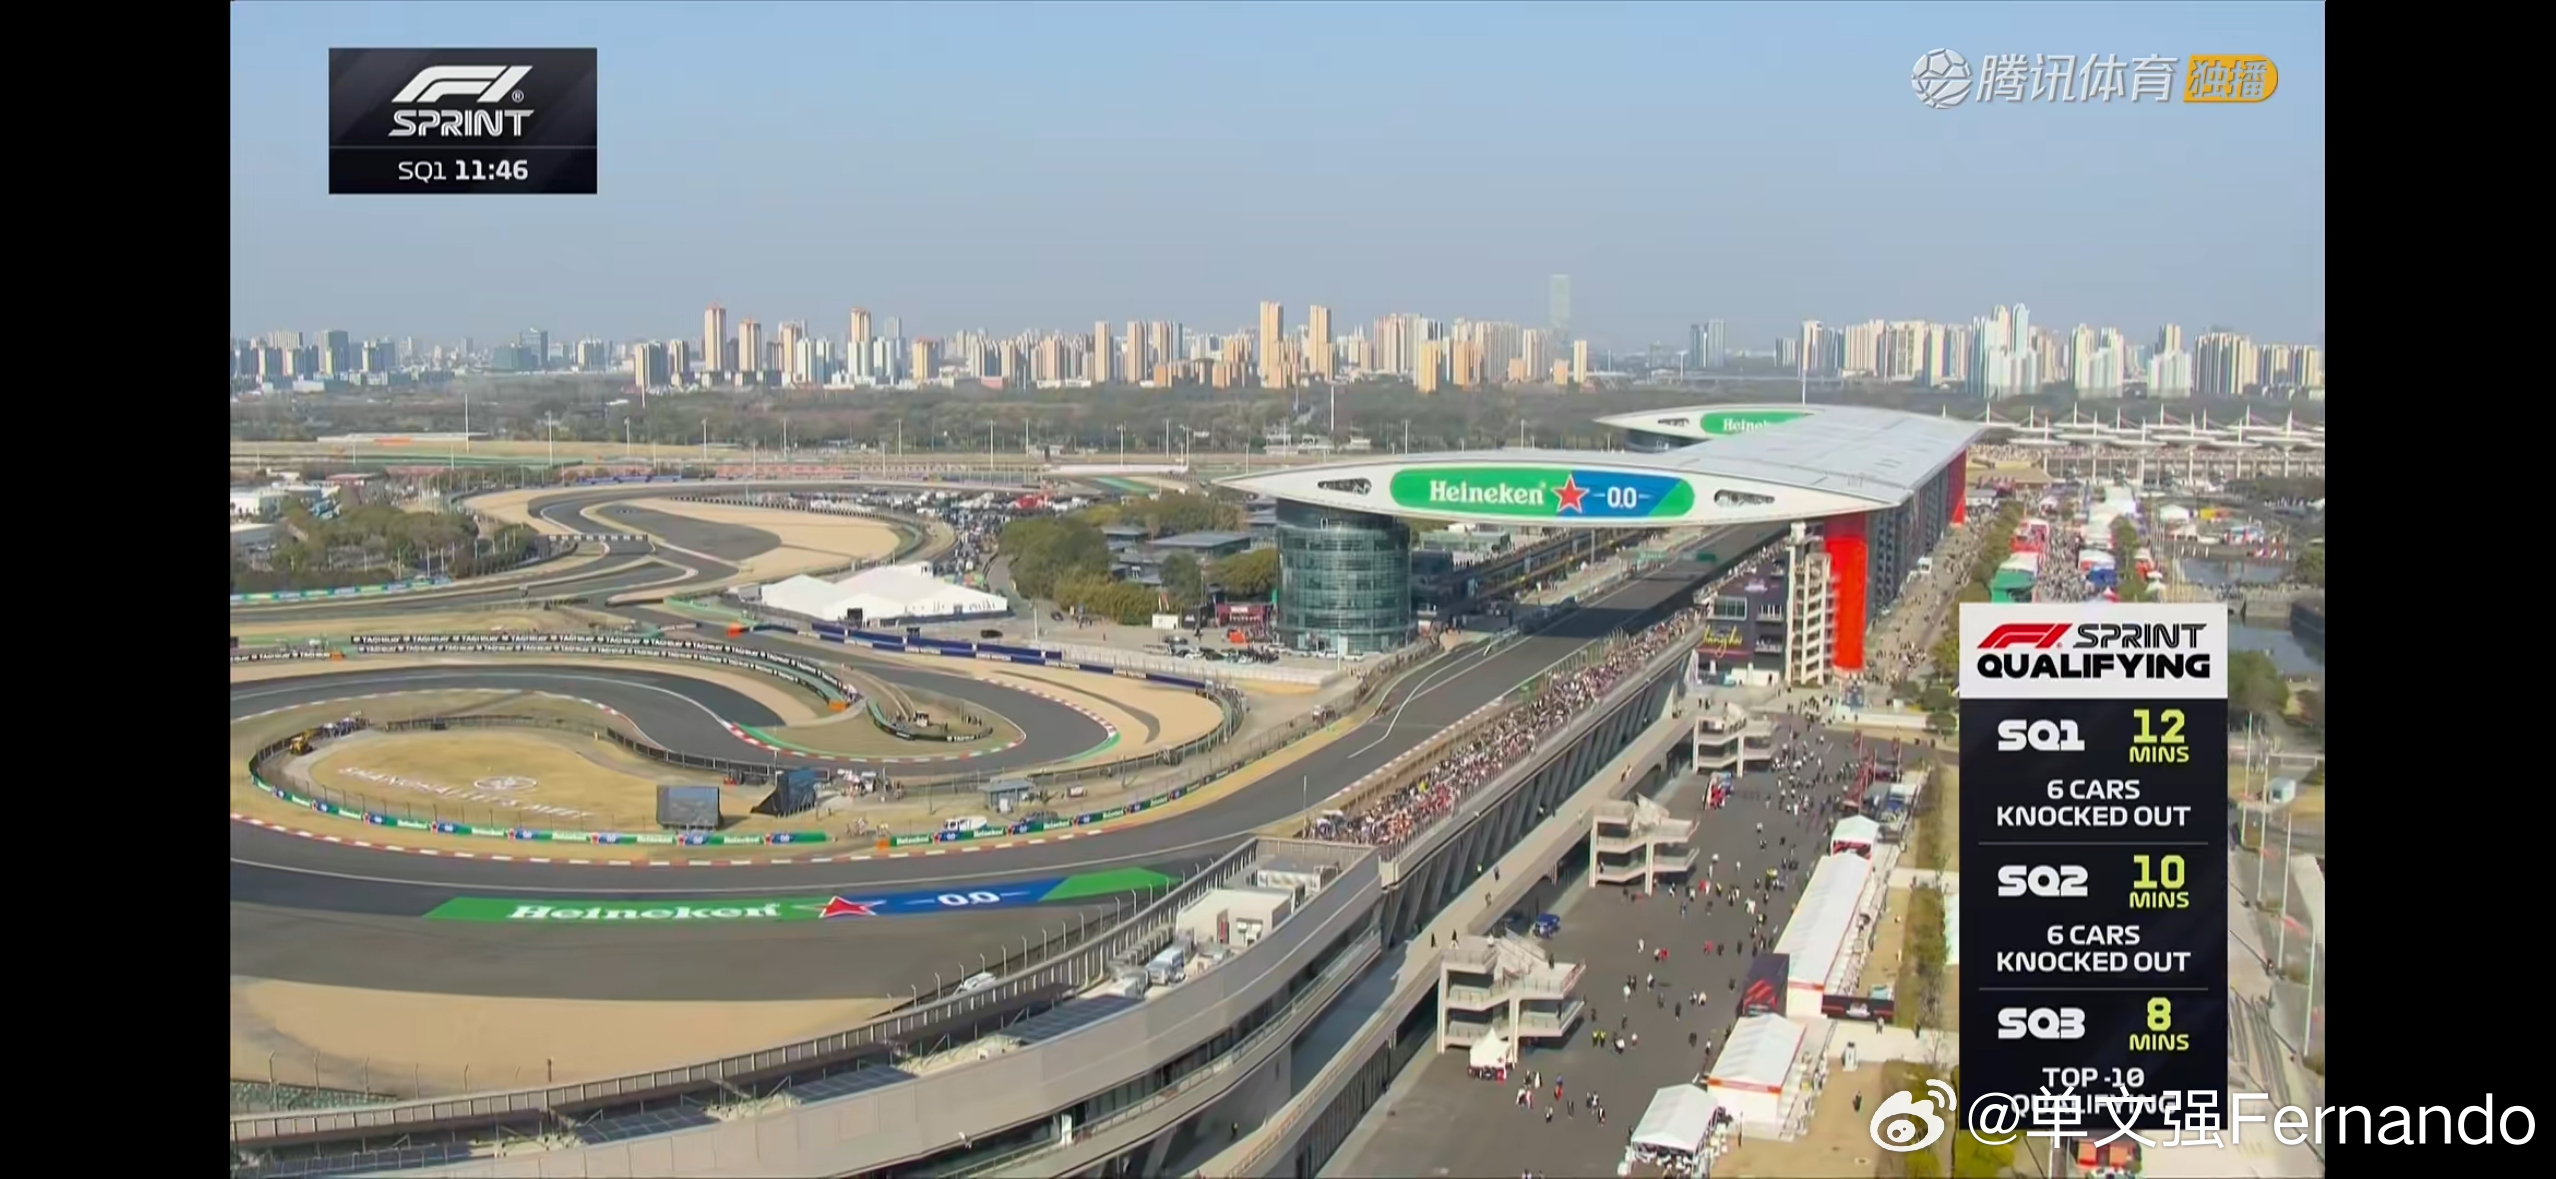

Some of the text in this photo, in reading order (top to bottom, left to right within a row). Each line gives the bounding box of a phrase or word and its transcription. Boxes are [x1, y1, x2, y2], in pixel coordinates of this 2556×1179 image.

[1723, 418, 1767, 432] Heine
[1429, 479, 1638, 510] Heineken 0.0
[508, 891, 1001, 920] Heineken 0.0
